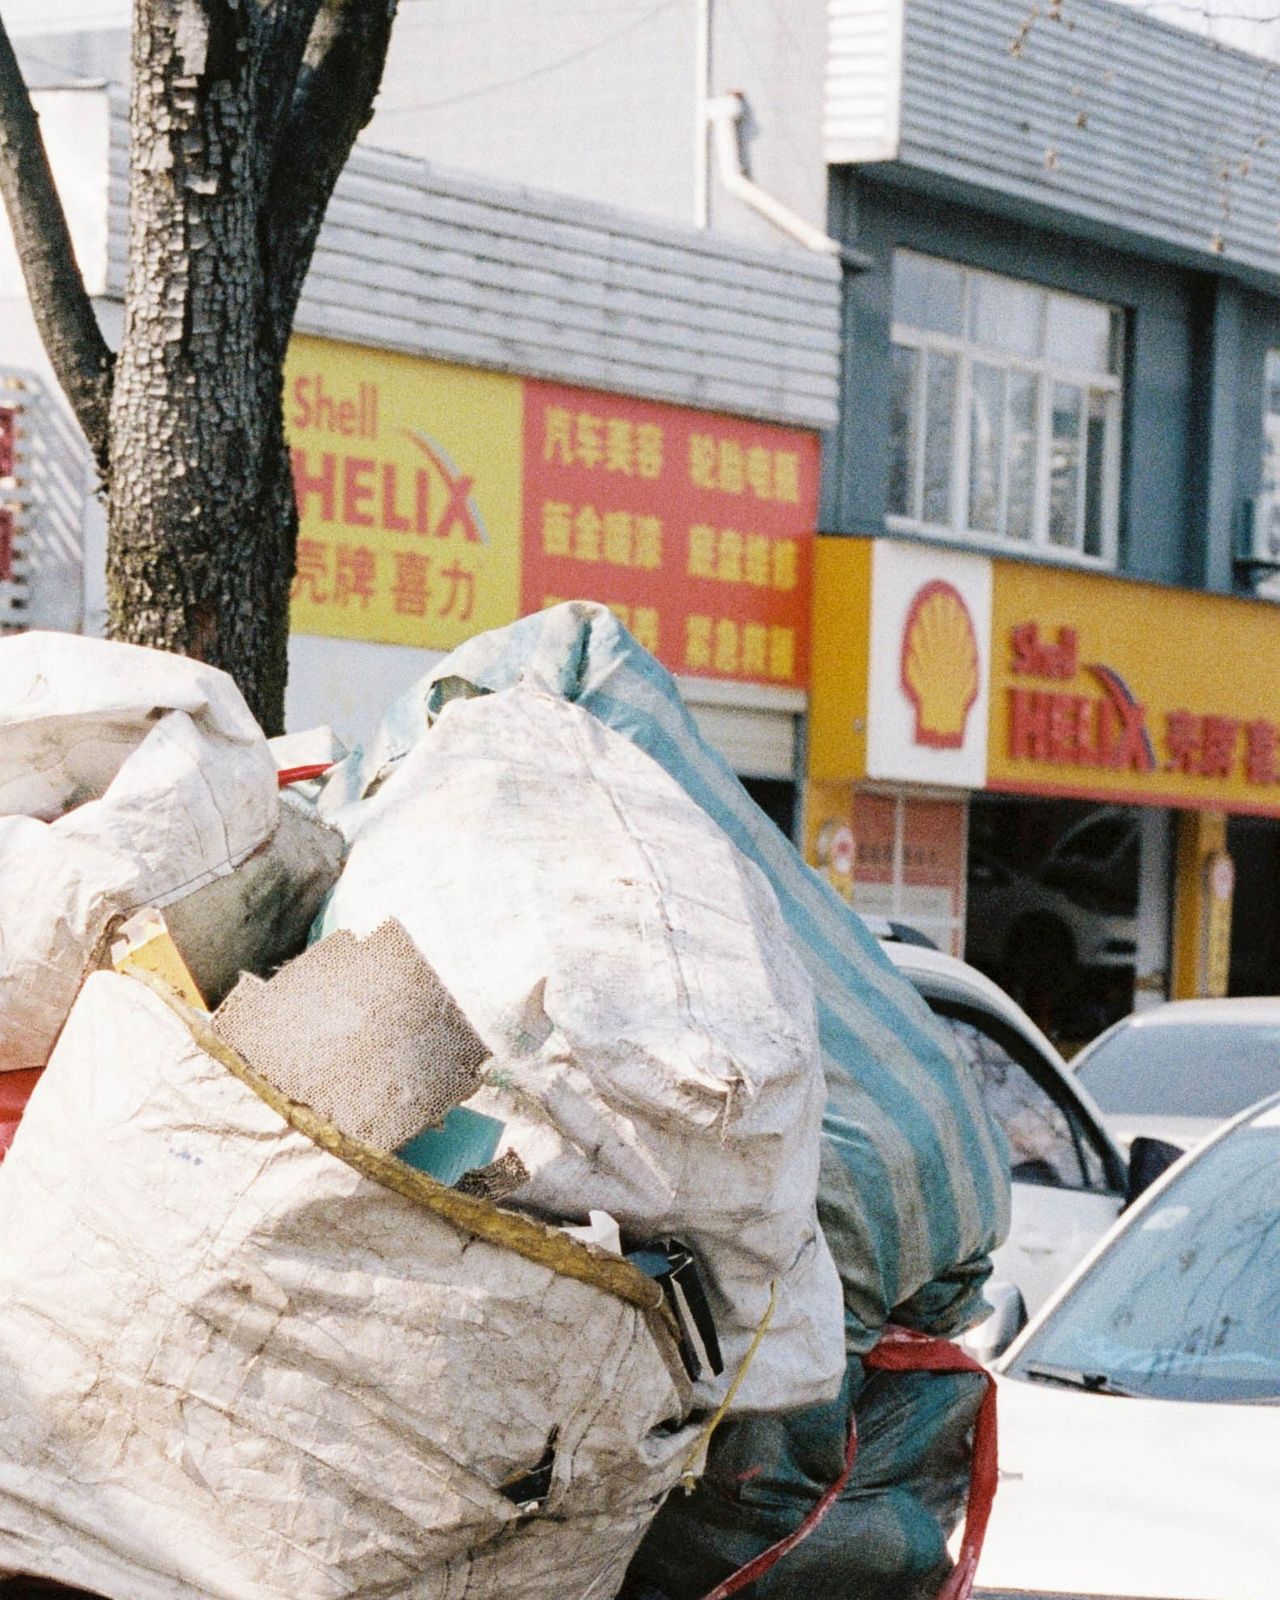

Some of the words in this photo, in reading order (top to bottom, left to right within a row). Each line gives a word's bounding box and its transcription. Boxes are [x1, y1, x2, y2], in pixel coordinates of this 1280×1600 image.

[292, 373, 379, 441] Shell
[542, 405, 664, 480] 汽车美容
[289, 443, 483, 546] HELIX
[288, 536, 476, 624] 壳牌喜力
[1006, 682, 1157, 773] HELIX
